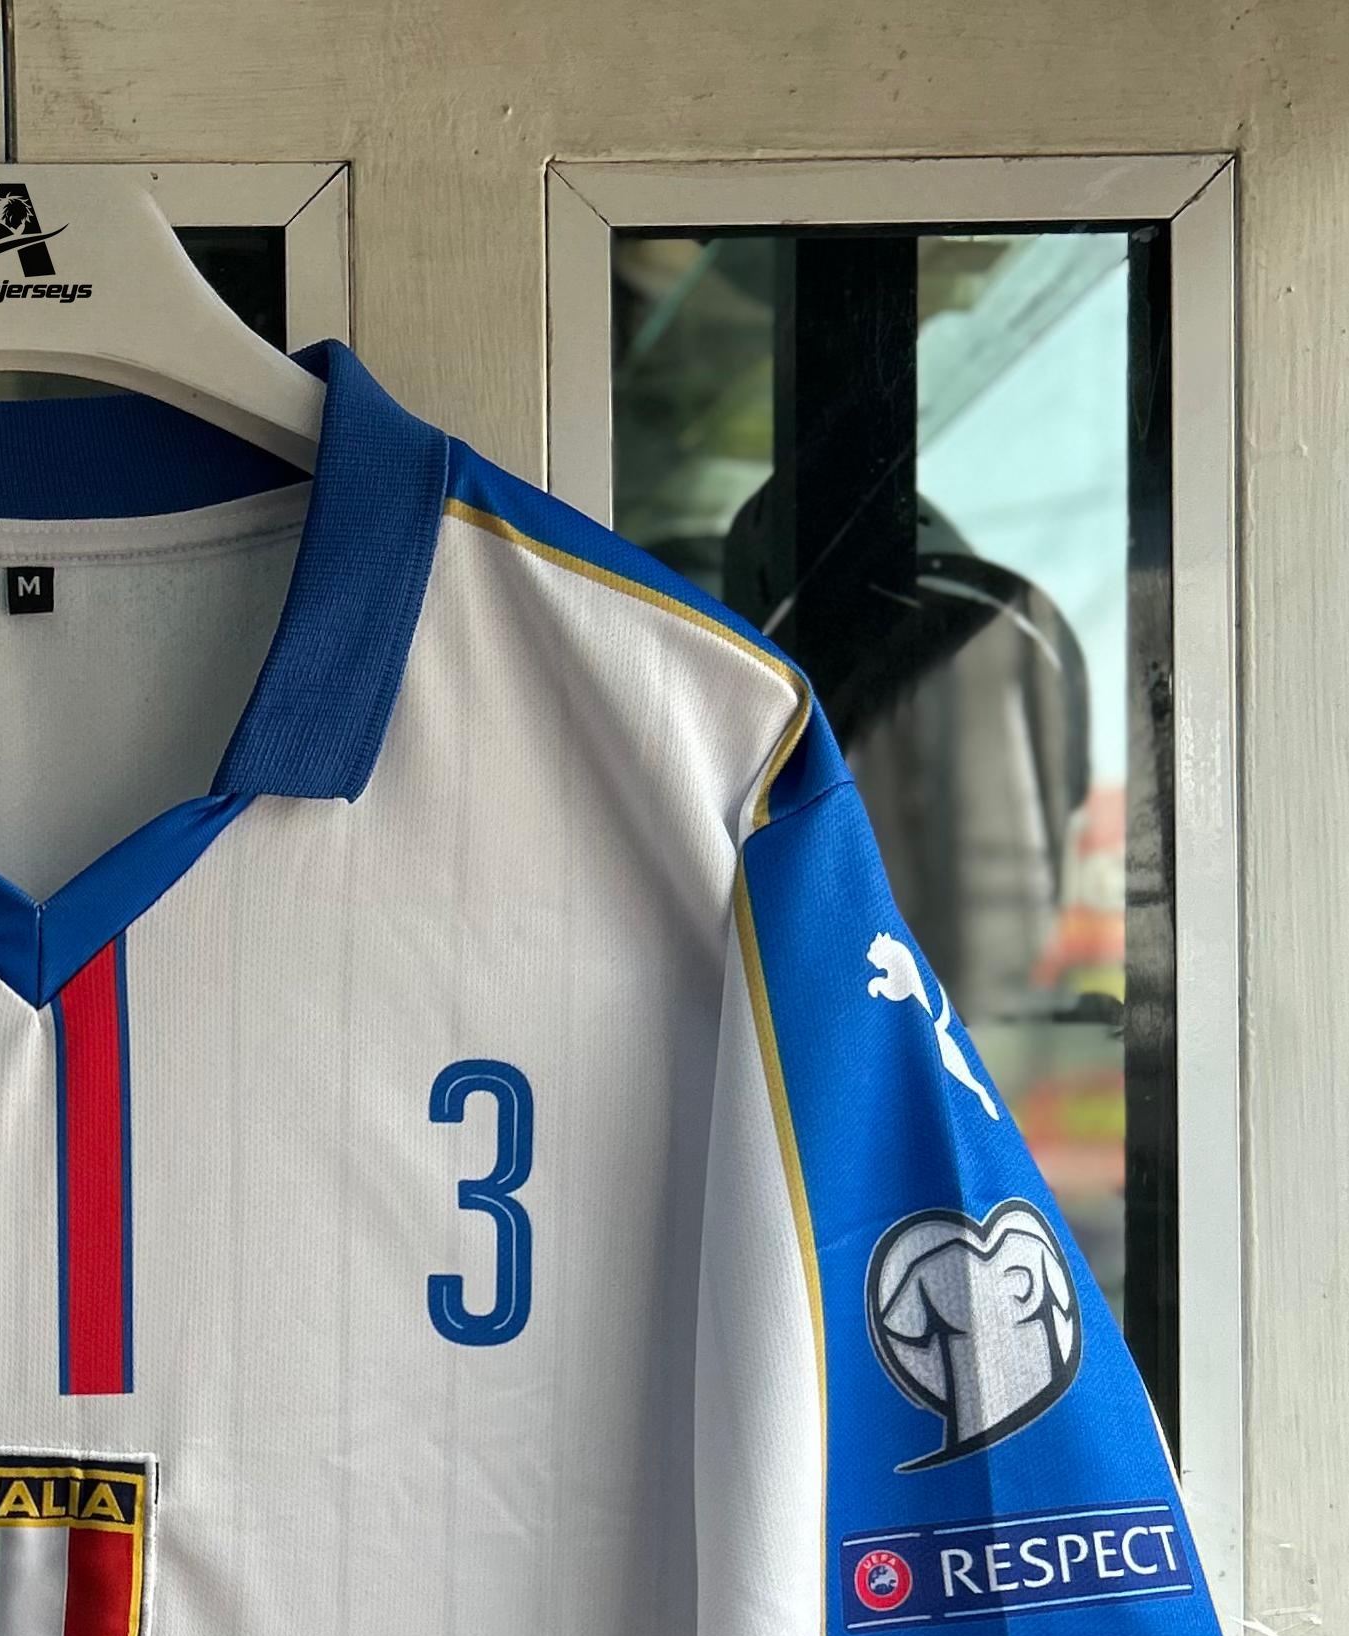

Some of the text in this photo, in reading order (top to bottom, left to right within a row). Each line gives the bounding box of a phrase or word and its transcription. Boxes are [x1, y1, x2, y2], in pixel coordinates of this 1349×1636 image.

[17, 575, 41, 597] M
[426, 1058, 534, 1348] 3
[862, 1553, 897, 1570] UEFA
[939, 1524, 1179, 1598] RESPECT
